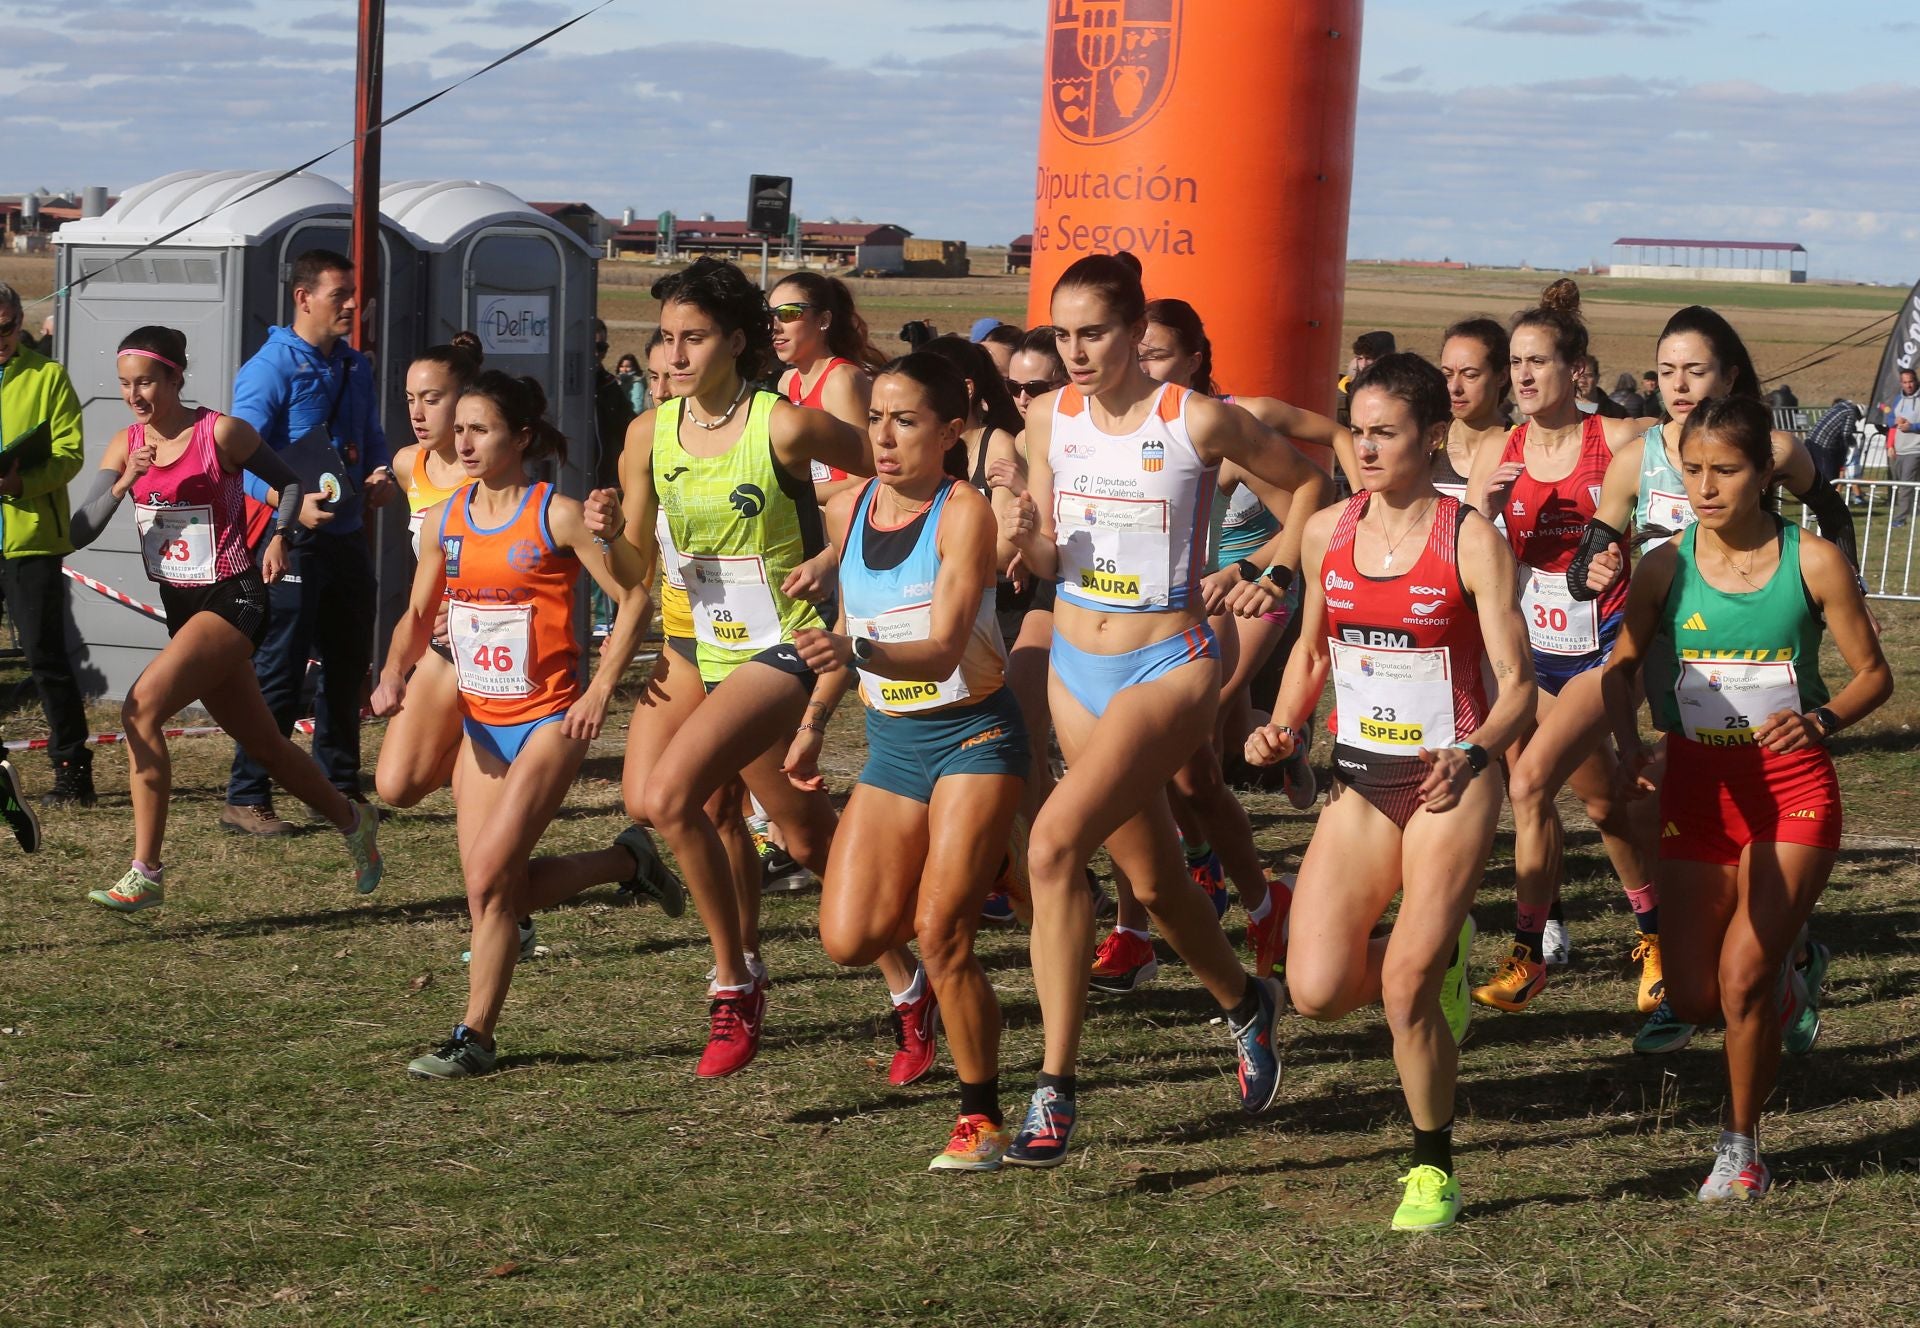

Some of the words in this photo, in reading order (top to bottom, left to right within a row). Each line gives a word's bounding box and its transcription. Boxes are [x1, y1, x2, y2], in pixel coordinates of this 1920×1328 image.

[1036, 164, 1197, 209] Diputación
[1056, 214, 1195, 256] Segovia
[1096, 476, 1138, 488] Diputació
[1108, 489, 1145, 500] València
[1098, 511, 1133, 521] Diputación
[158, 538, 191, 562] 43
[1095, 557, 1117, 574] 26
[1081, 574, 1140, 595] SAURA
[1325, 570, 1354, 591] Bilbao
[712, 609, 733, 623] 28
[1402, 616, 1451, 626] emteSPORT
[1533, 604, 1567, 631] 30
[713, 625, 749, 640] RUIZ
[878, 622, 911, 633] Diputación
[1369, 630, 1409, 649] BM
[473, 645, 513, 672] 46
[1374, 660, 1411, 671] Diputación
[1386, 671, 1413, 680] Segovia
[880, 682, 938, 702] CAMPO
[1371, 705, 1397, 722] 23
[1724, 715, 1750, 729] 25
[1360, 722, 1423, 741] ESPEJO
